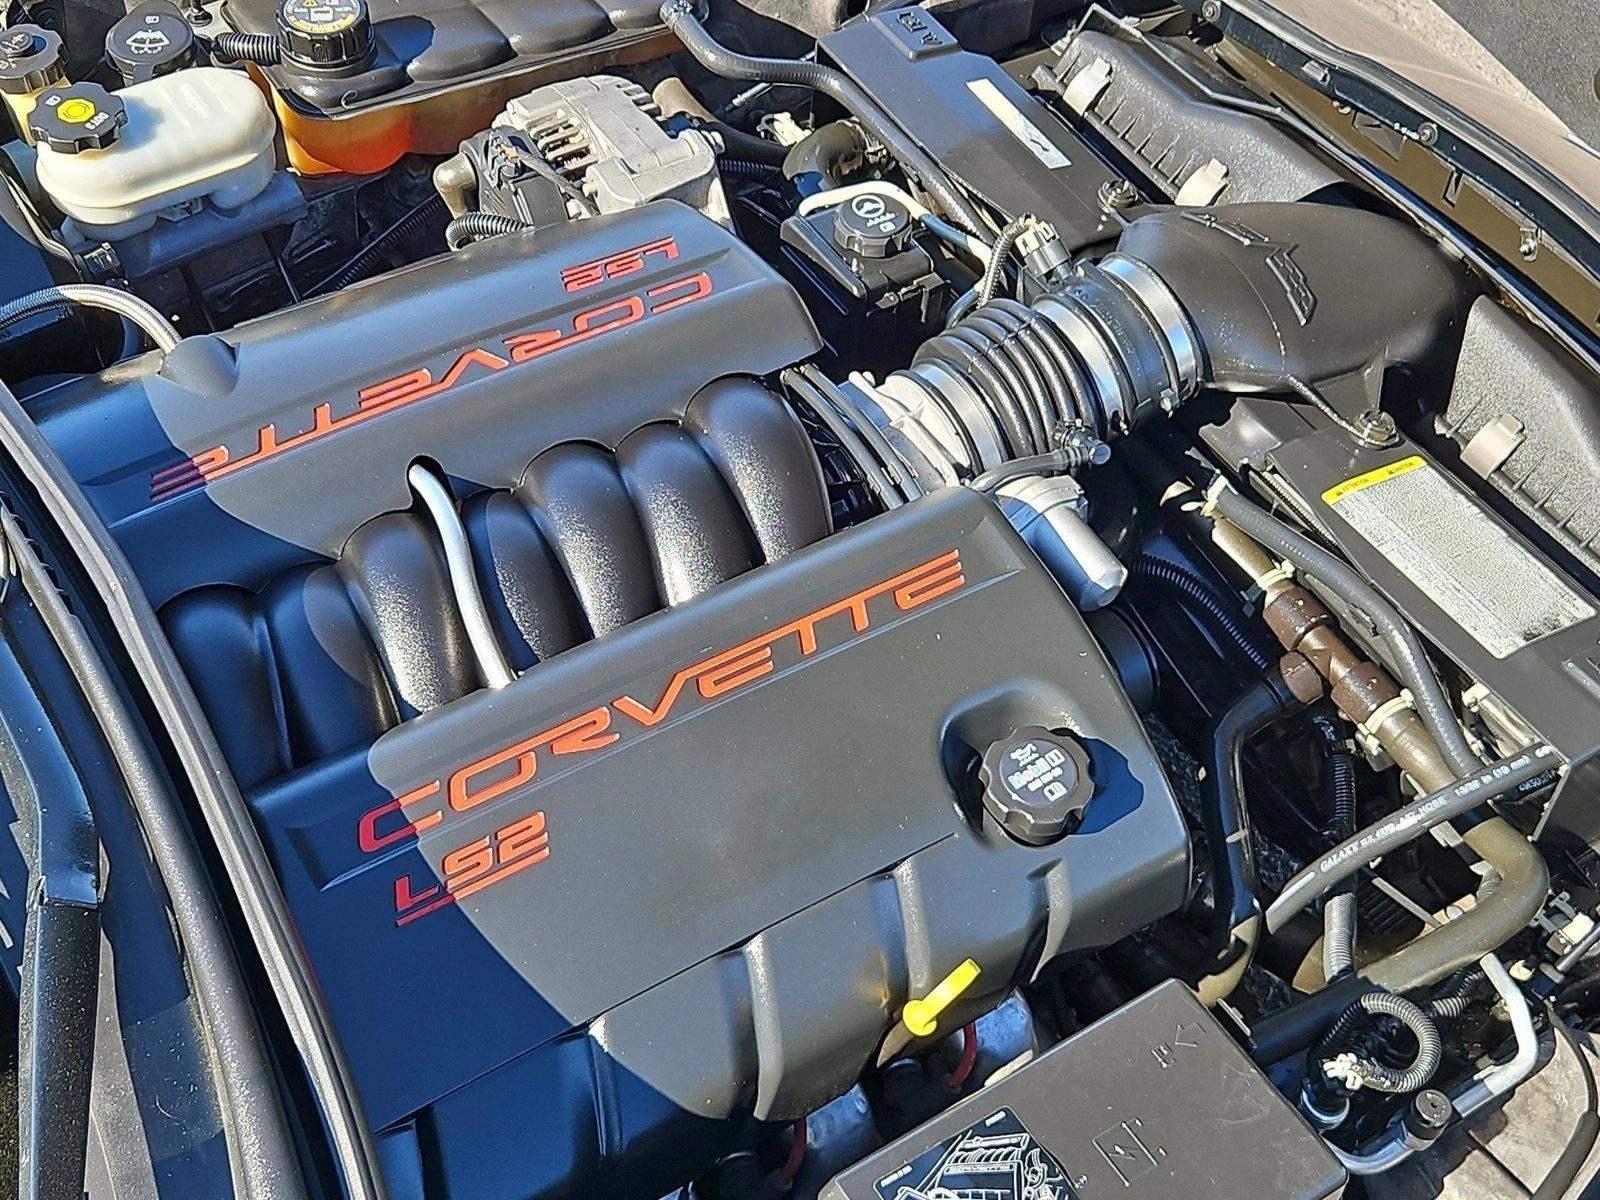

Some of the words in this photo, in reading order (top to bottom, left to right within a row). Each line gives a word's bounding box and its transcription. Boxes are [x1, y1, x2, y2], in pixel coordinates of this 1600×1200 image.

[560, 236, 679, 292] LS2
[150, 272, 712, 501] CORVETTE
[358, 549, 965, 853] CORVETTE
[394, 811, 550, 927] LS2
[1320, 842, 1359, 872] GALAXY
[1419, 795, 1447, 817] HOSE
[1454, 778, 1480, 797] 13/32
